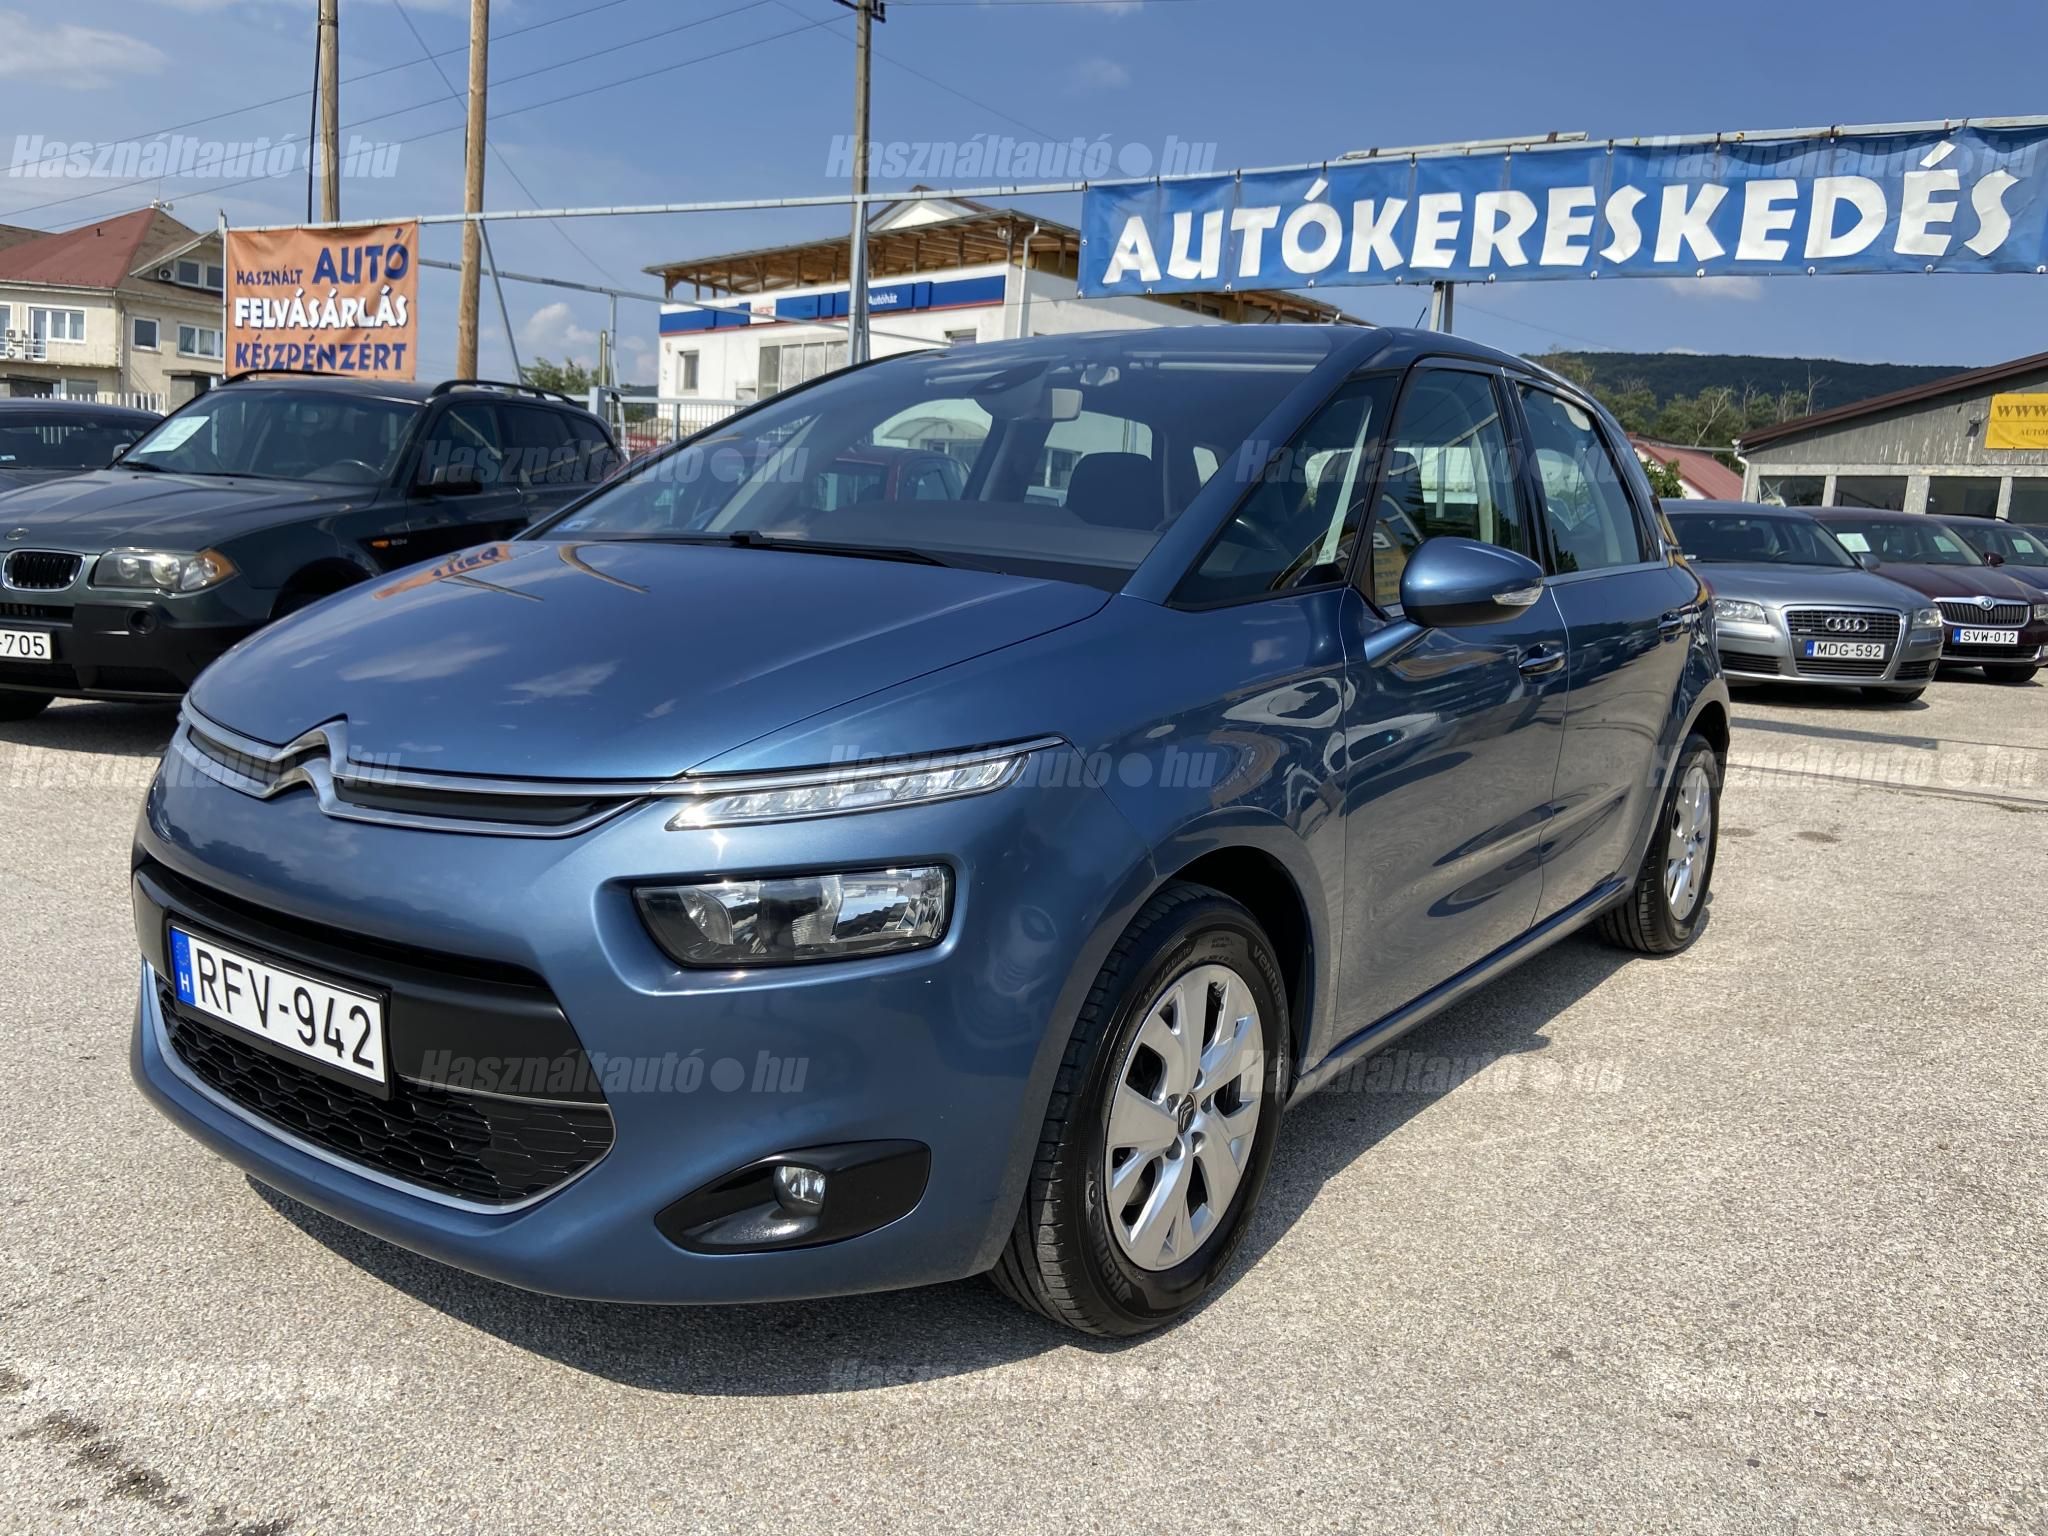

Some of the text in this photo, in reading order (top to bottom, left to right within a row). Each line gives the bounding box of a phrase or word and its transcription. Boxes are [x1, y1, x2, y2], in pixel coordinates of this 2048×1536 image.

[1102, 140, 2020, 284] AUTÓKERESKEDÉS
[236, 228, 409, 286] HASZNÁLT AUTÓ
[234, 285, 409, 329] FELVÁSÁRLÁS
[235, 333, 407, 371] KÉSZPÉNZÉRT
[1817, 643, 1882, 658] MDG-592
[1963, 630, 2016, 643] SVW-012
[196, 948, 375, 1070] RFV-942
